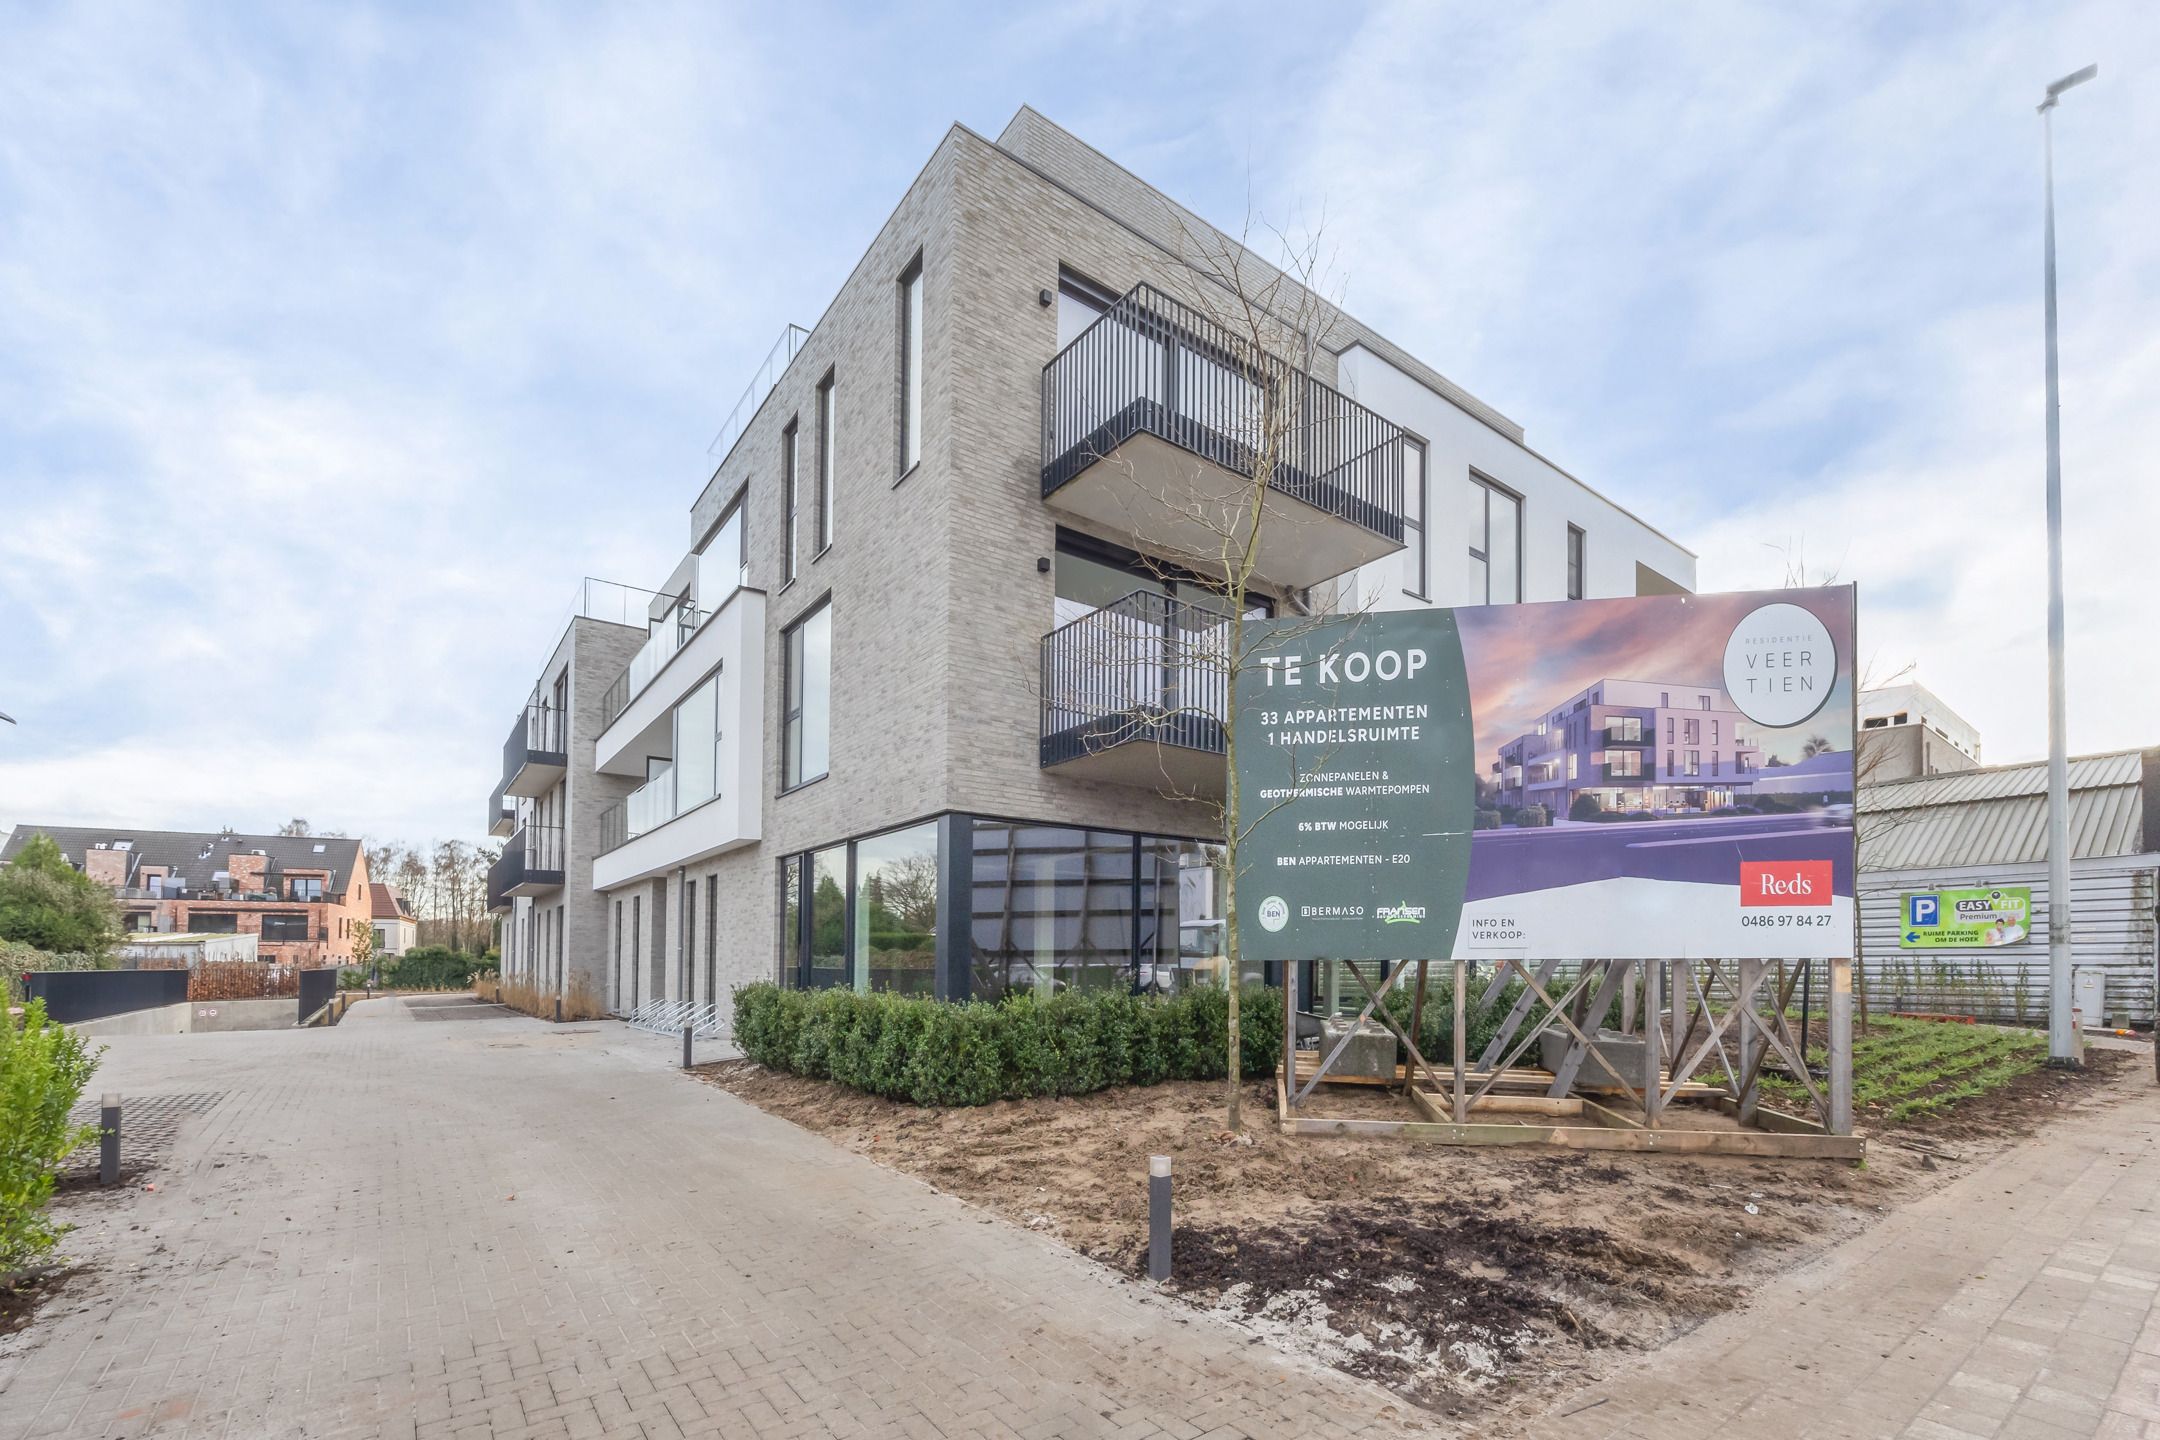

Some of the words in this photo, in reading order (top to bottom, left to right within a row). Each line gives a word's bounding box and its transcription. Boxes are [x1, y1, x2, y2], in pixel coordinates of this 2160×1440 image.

[1745, 634, 1812, 644] RESIDENTIE
[1746, 651, 1812, 669] VEER
[1260, 655, 1302, 687] TE
[1319, 648, 1427, 684] KOOP
[1746, 676, 1813, 694] TIEN
[1260, 711, 1279, 726] 33
[1284, 704, 1428, 725] APPARTEMENTEN
[1267, 733, 1274, 746] 1
[1280, 726, 1420, 745] HANDELSRUIMTE
[1300, 771, 1379, 783] ZONNEPANELEN
[1382, 771, 1389, 780] &
[1260, 787, 1343, 799] GEOTHERMISCHE
[1345, 784, 1430, 796] WARMTEPOMPEN
[1298, 822, 1312, 832] 6%
[1315, 821, 1337, 831] BTW
[1339, 820, 1389, 830] MOGELIJK
[1277, 857, 1296, 866] BEN
[1299, 855, 1382, 865] APPARTEMENTEN
[1392, 854, 1411, 864] E20
[1760, 872, 1812, 895] Reds
[1311, 906, 1364, 916] BERMASO
[1915, 899, 1936, 922] P
[1960, 900, 1991, 911] EASY
[2000, 899, 2020, 910] FIT
[1266, 910, 1280, 918] BEN
[1960, 912, 1998, 920] Premium
[1472, 918, 1497, 927] INFO
[1501, 918, 1515, 927] EN
[1741, 915, 1774, 927] 0486
[1777, 915, 1793, 927] 97
[1796, 915, 1813, 927] 84
[1816, 915, 1832, 926] 27
[1472, 931, 1526, 940] VERKOOP:
